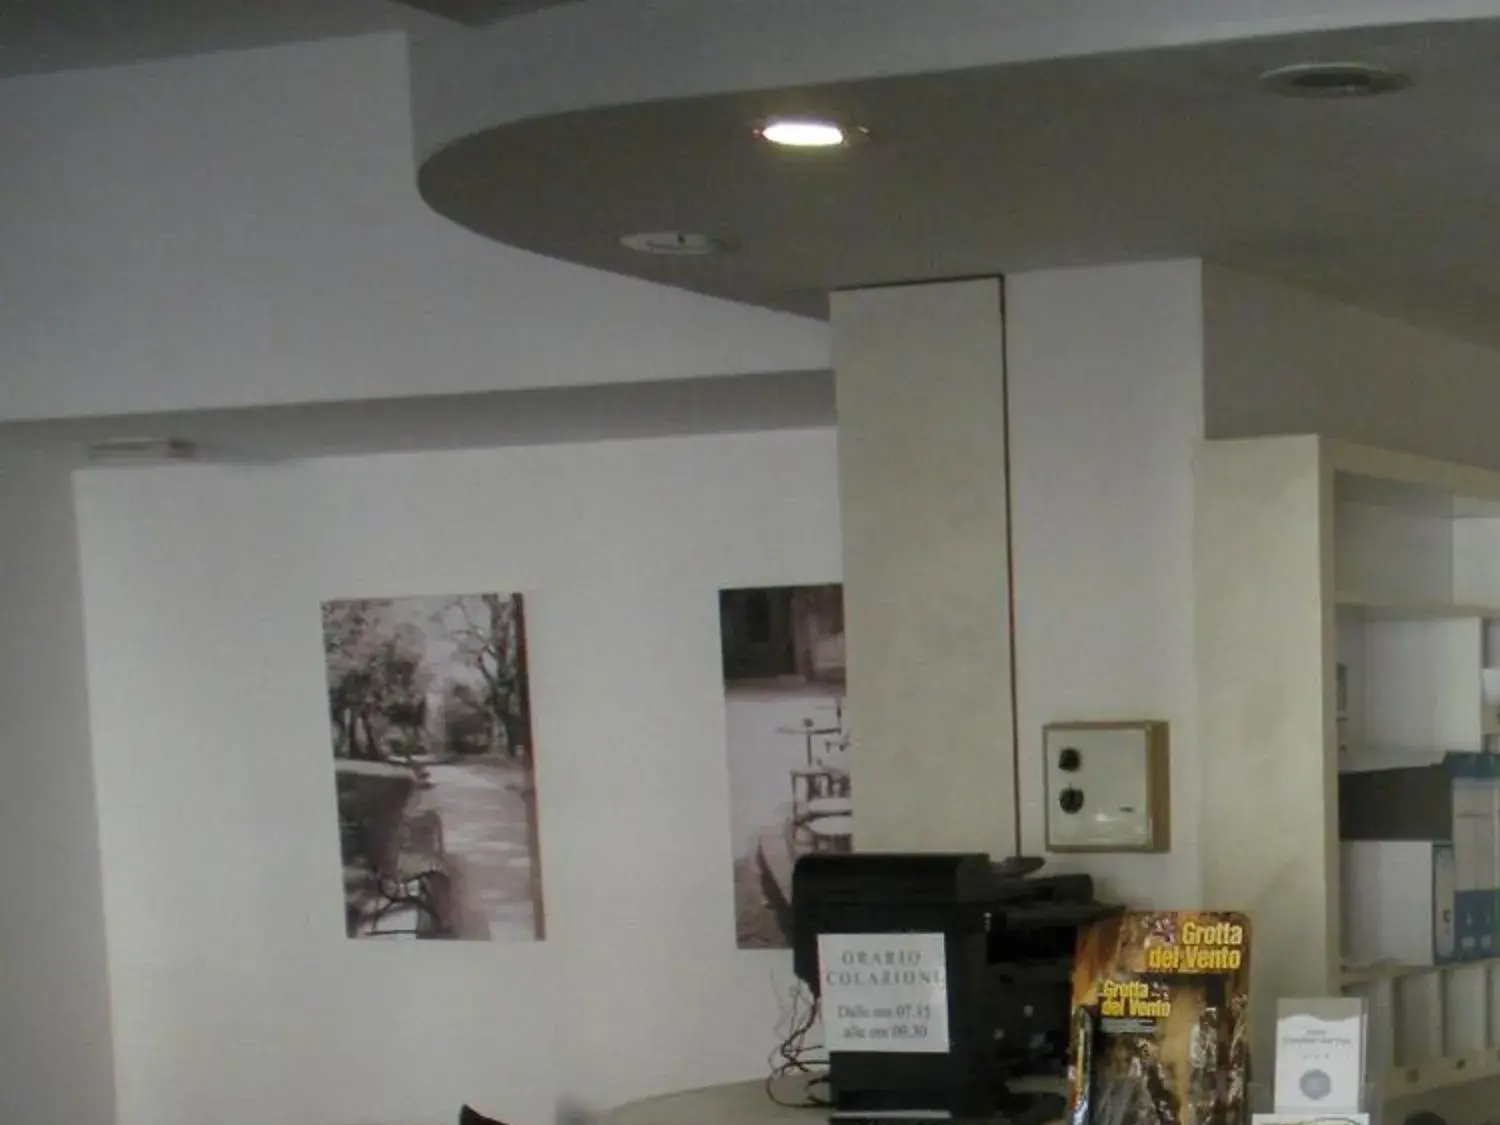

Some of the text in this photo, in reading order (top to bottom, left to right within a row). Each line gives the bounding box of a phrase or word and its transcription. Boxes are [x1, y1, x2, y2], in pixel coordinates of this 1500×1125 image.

[1182, 921, 1243, 945] Grotta
[841, 949, 921, 966] ORARIO
[1150, 945, 1241, 969] del Vento
[1102, 979, 1149, 998] Grotta
[1102, 998, 1171, 1017] del Vento
